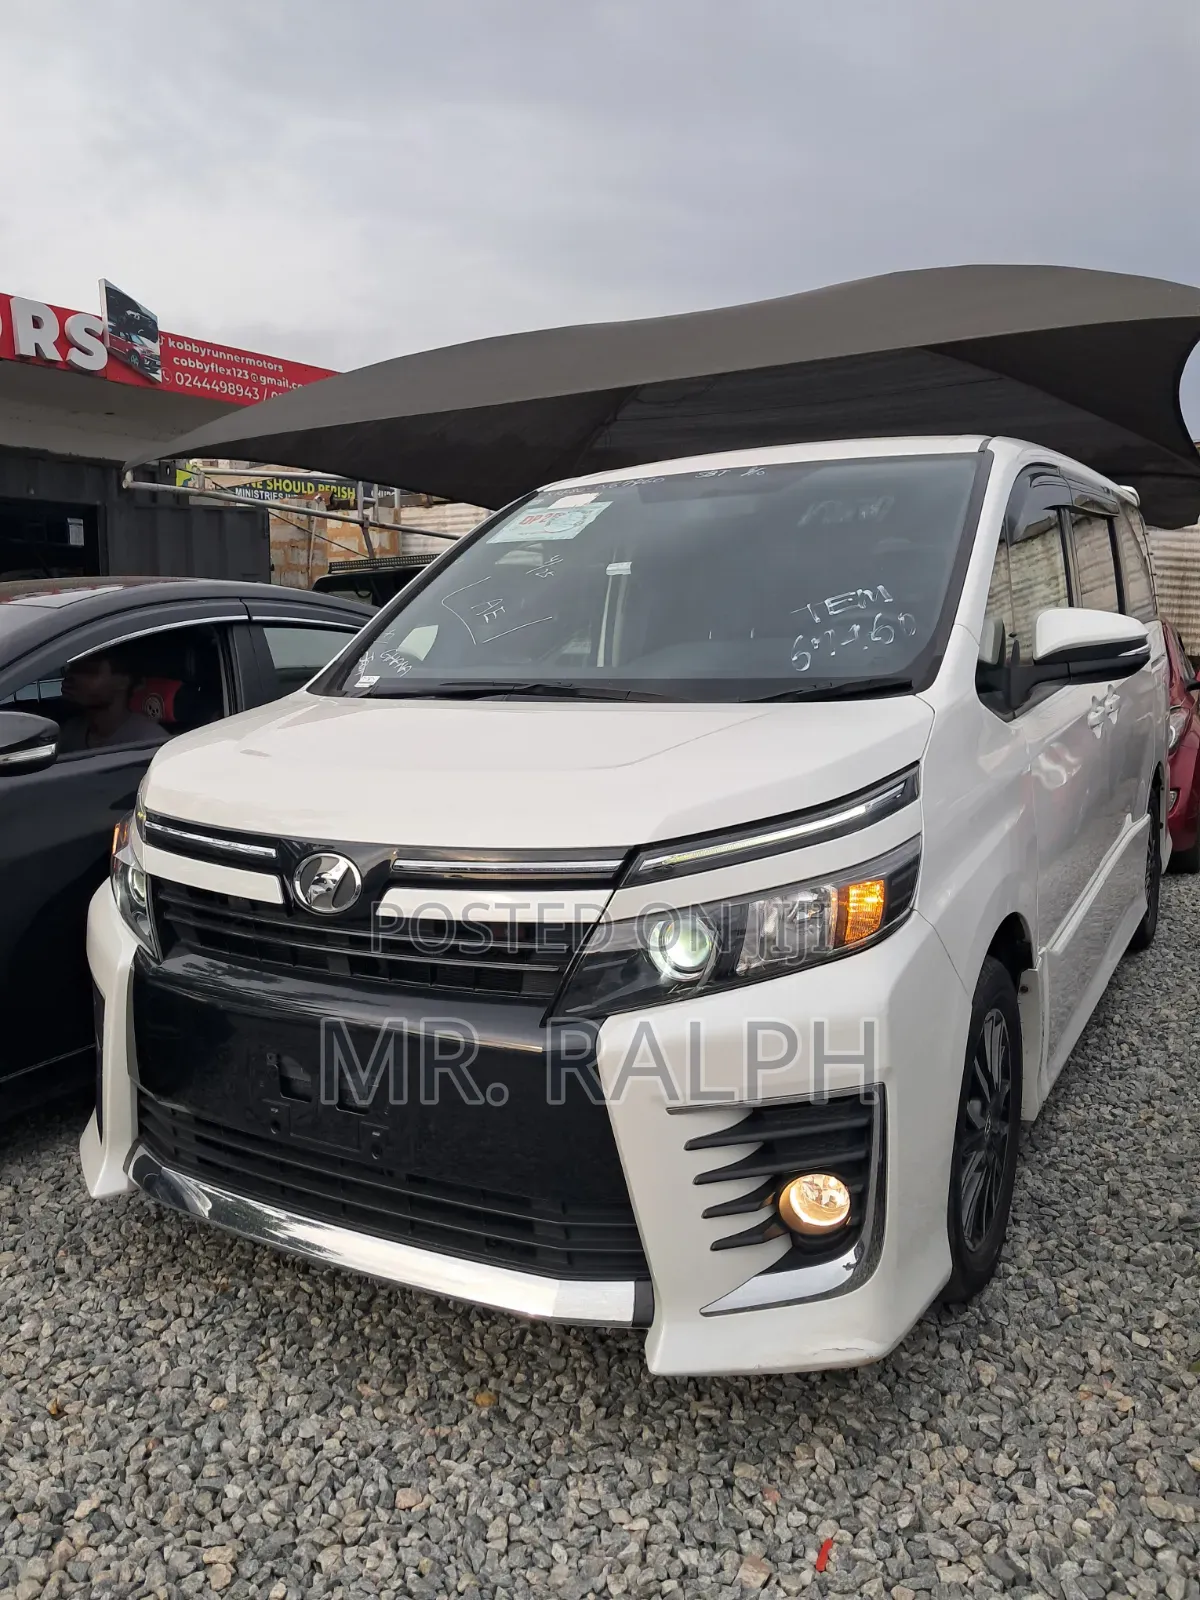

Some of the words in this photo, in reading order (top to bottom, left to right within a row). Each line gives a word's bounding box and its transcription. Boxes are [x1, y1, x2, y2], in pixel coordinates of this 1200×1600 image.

[0, 296, 108, 371] RS
[168, 337, 283, 372] kobbyrunnermotors
[173, 356, 303, 390] cobbyflex123@gmail.co
[175, 371, 260, 400] 0244498943
[235, 487, 283, 500] MINISTRIES
[267, 478, 315, 495] SHOULD
[318, 484, 356, 499] PERISH
